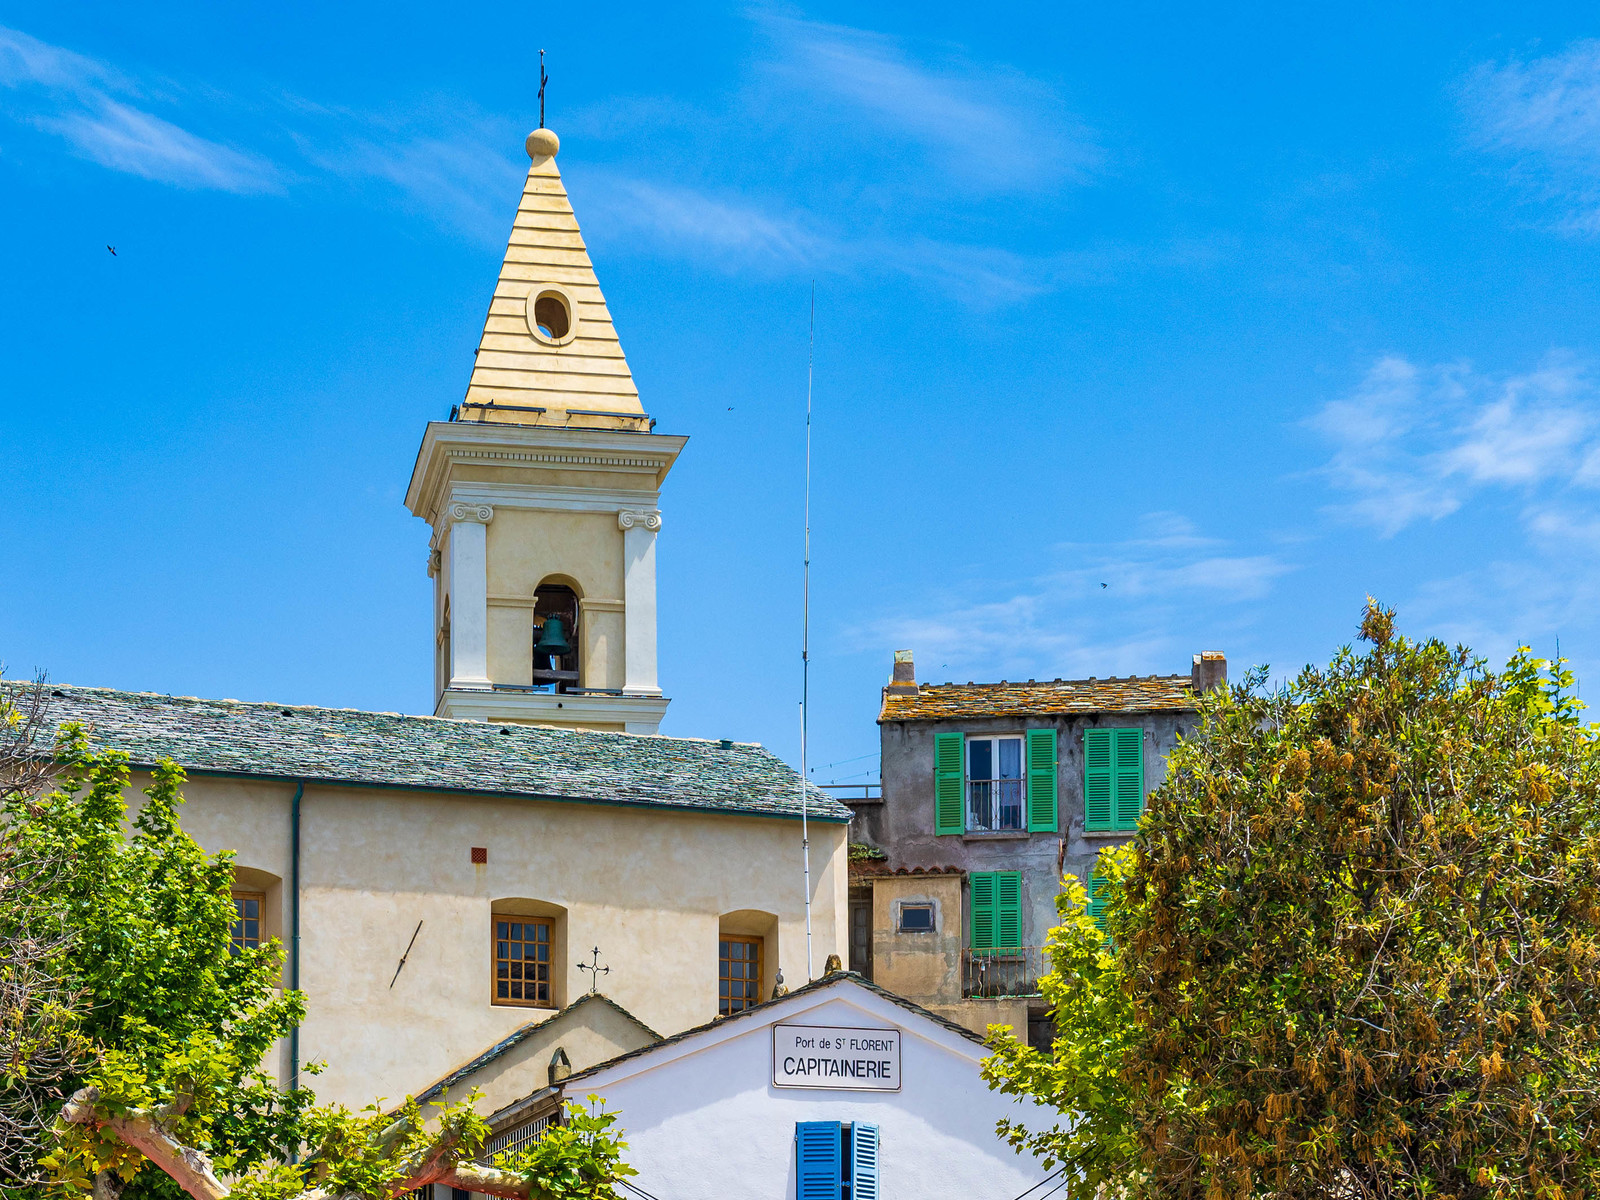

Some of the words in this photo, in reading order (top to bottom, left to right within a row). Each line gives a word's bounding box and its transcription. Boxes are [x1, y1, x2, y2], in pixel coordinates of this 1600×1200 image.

[795, 1036, 815, 1049] Port
[819, 1038, 831, 1050] de
[850, 1039, 894, 1051] FLORENT
[783, 1056, 891, 1078] CAPITAINERIE
